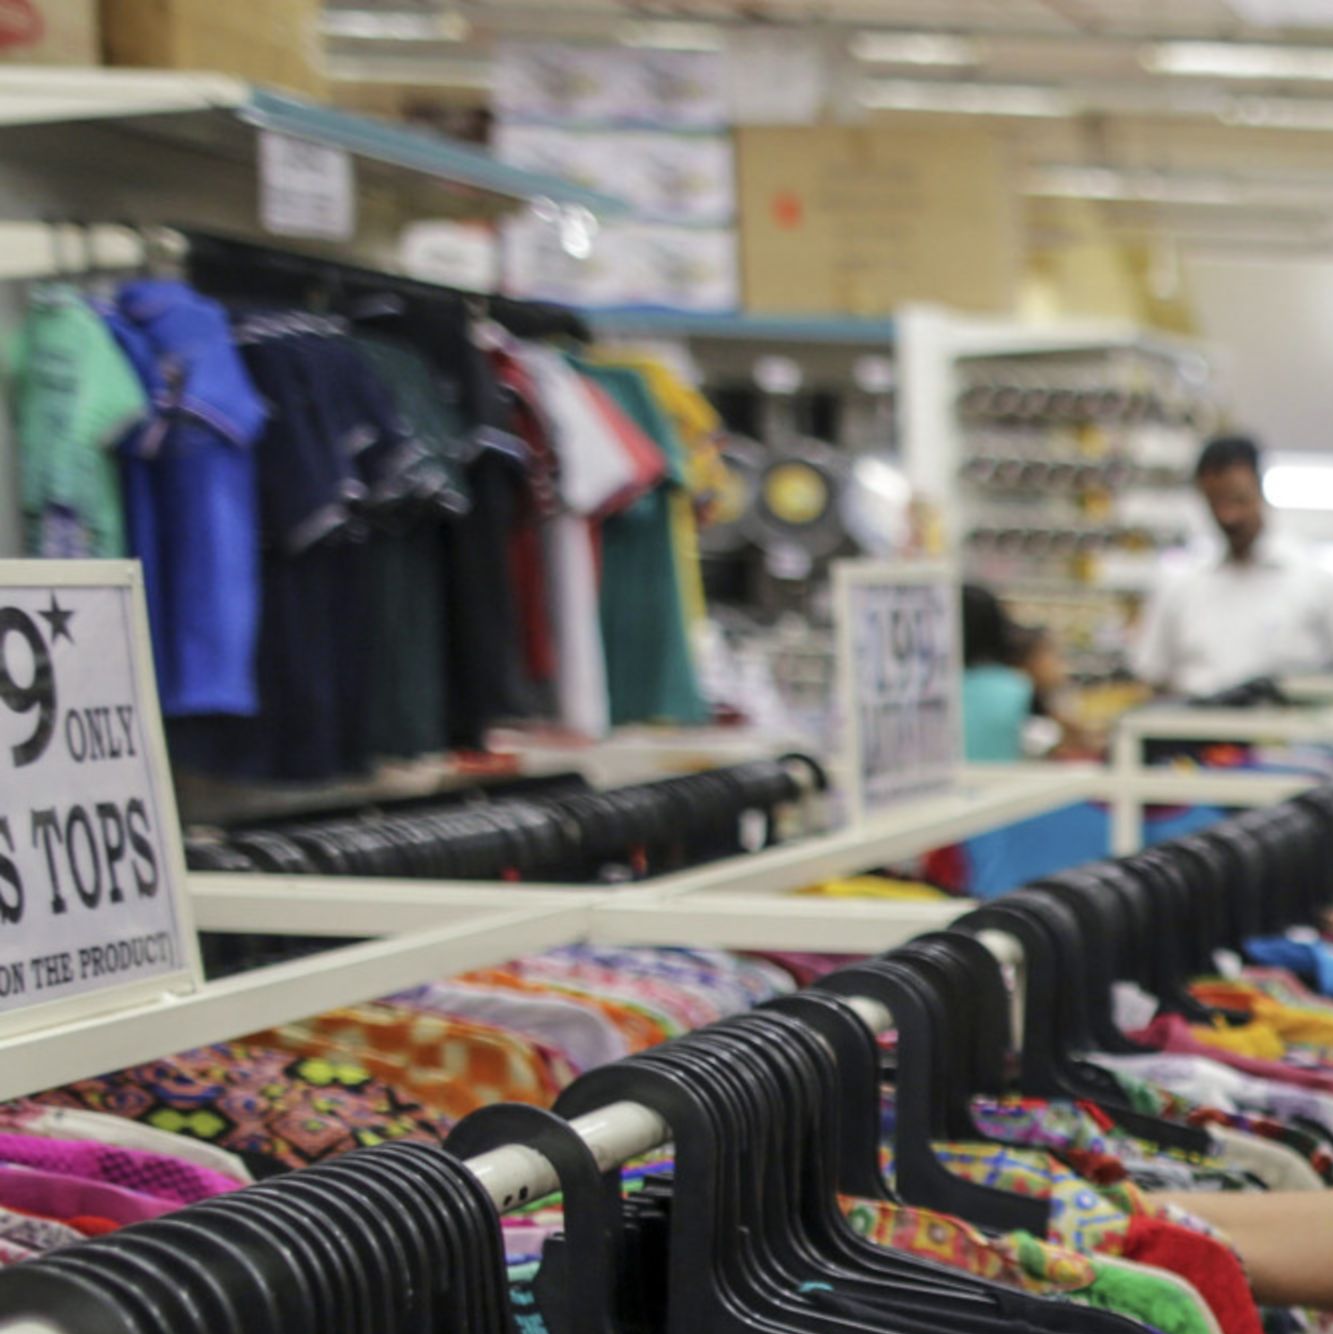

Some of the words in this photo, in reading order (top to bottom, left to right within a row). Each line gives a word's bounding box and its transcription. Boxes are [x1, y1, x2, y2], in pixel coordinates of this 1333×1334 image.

[65, 704, 137, 764] ONLY
[31, 796, 159, 915] TOPS
[31, 952, 74, 990] THE
